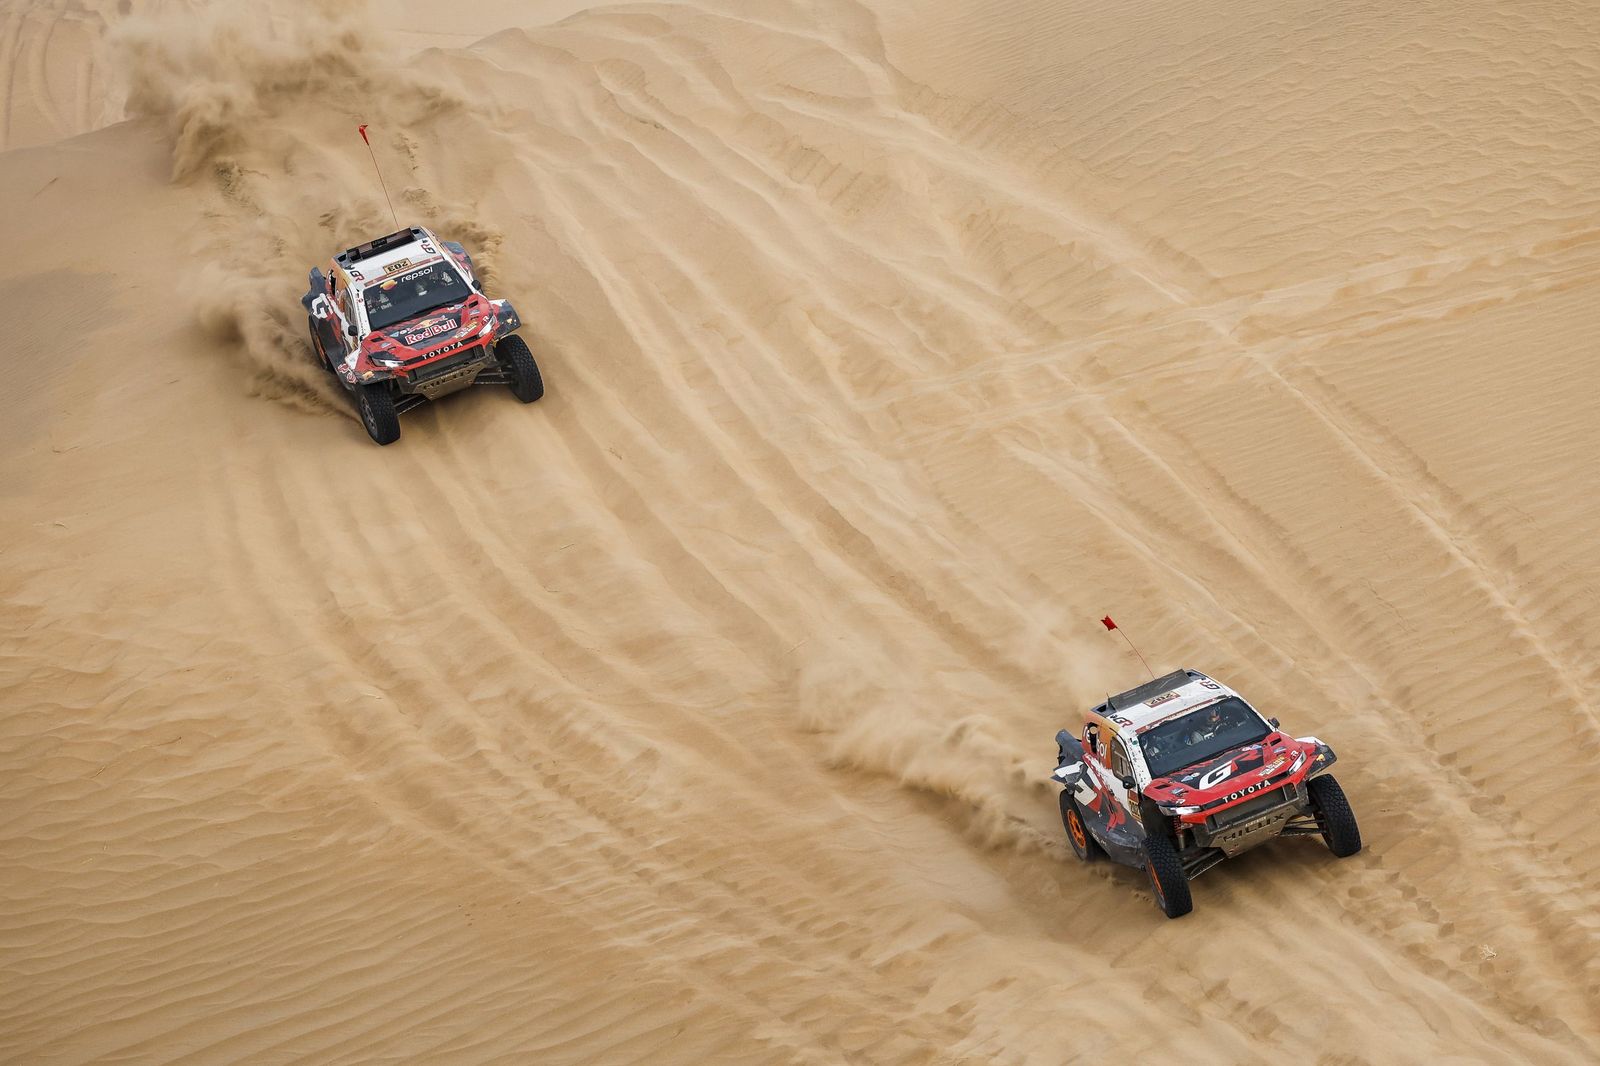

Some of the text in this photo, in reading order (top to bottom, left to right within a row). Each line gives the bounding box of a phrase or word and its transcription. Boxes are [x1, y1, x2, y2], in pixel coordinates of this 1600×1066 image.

[401, 267, 433, 282] repsol
[405, 328, 433, 345] Red
[430, 318, 458, 335] Bull
[422, 341, 464, 360] TOYOTA
[1222, 780, 1272, 803] TOYOTA
